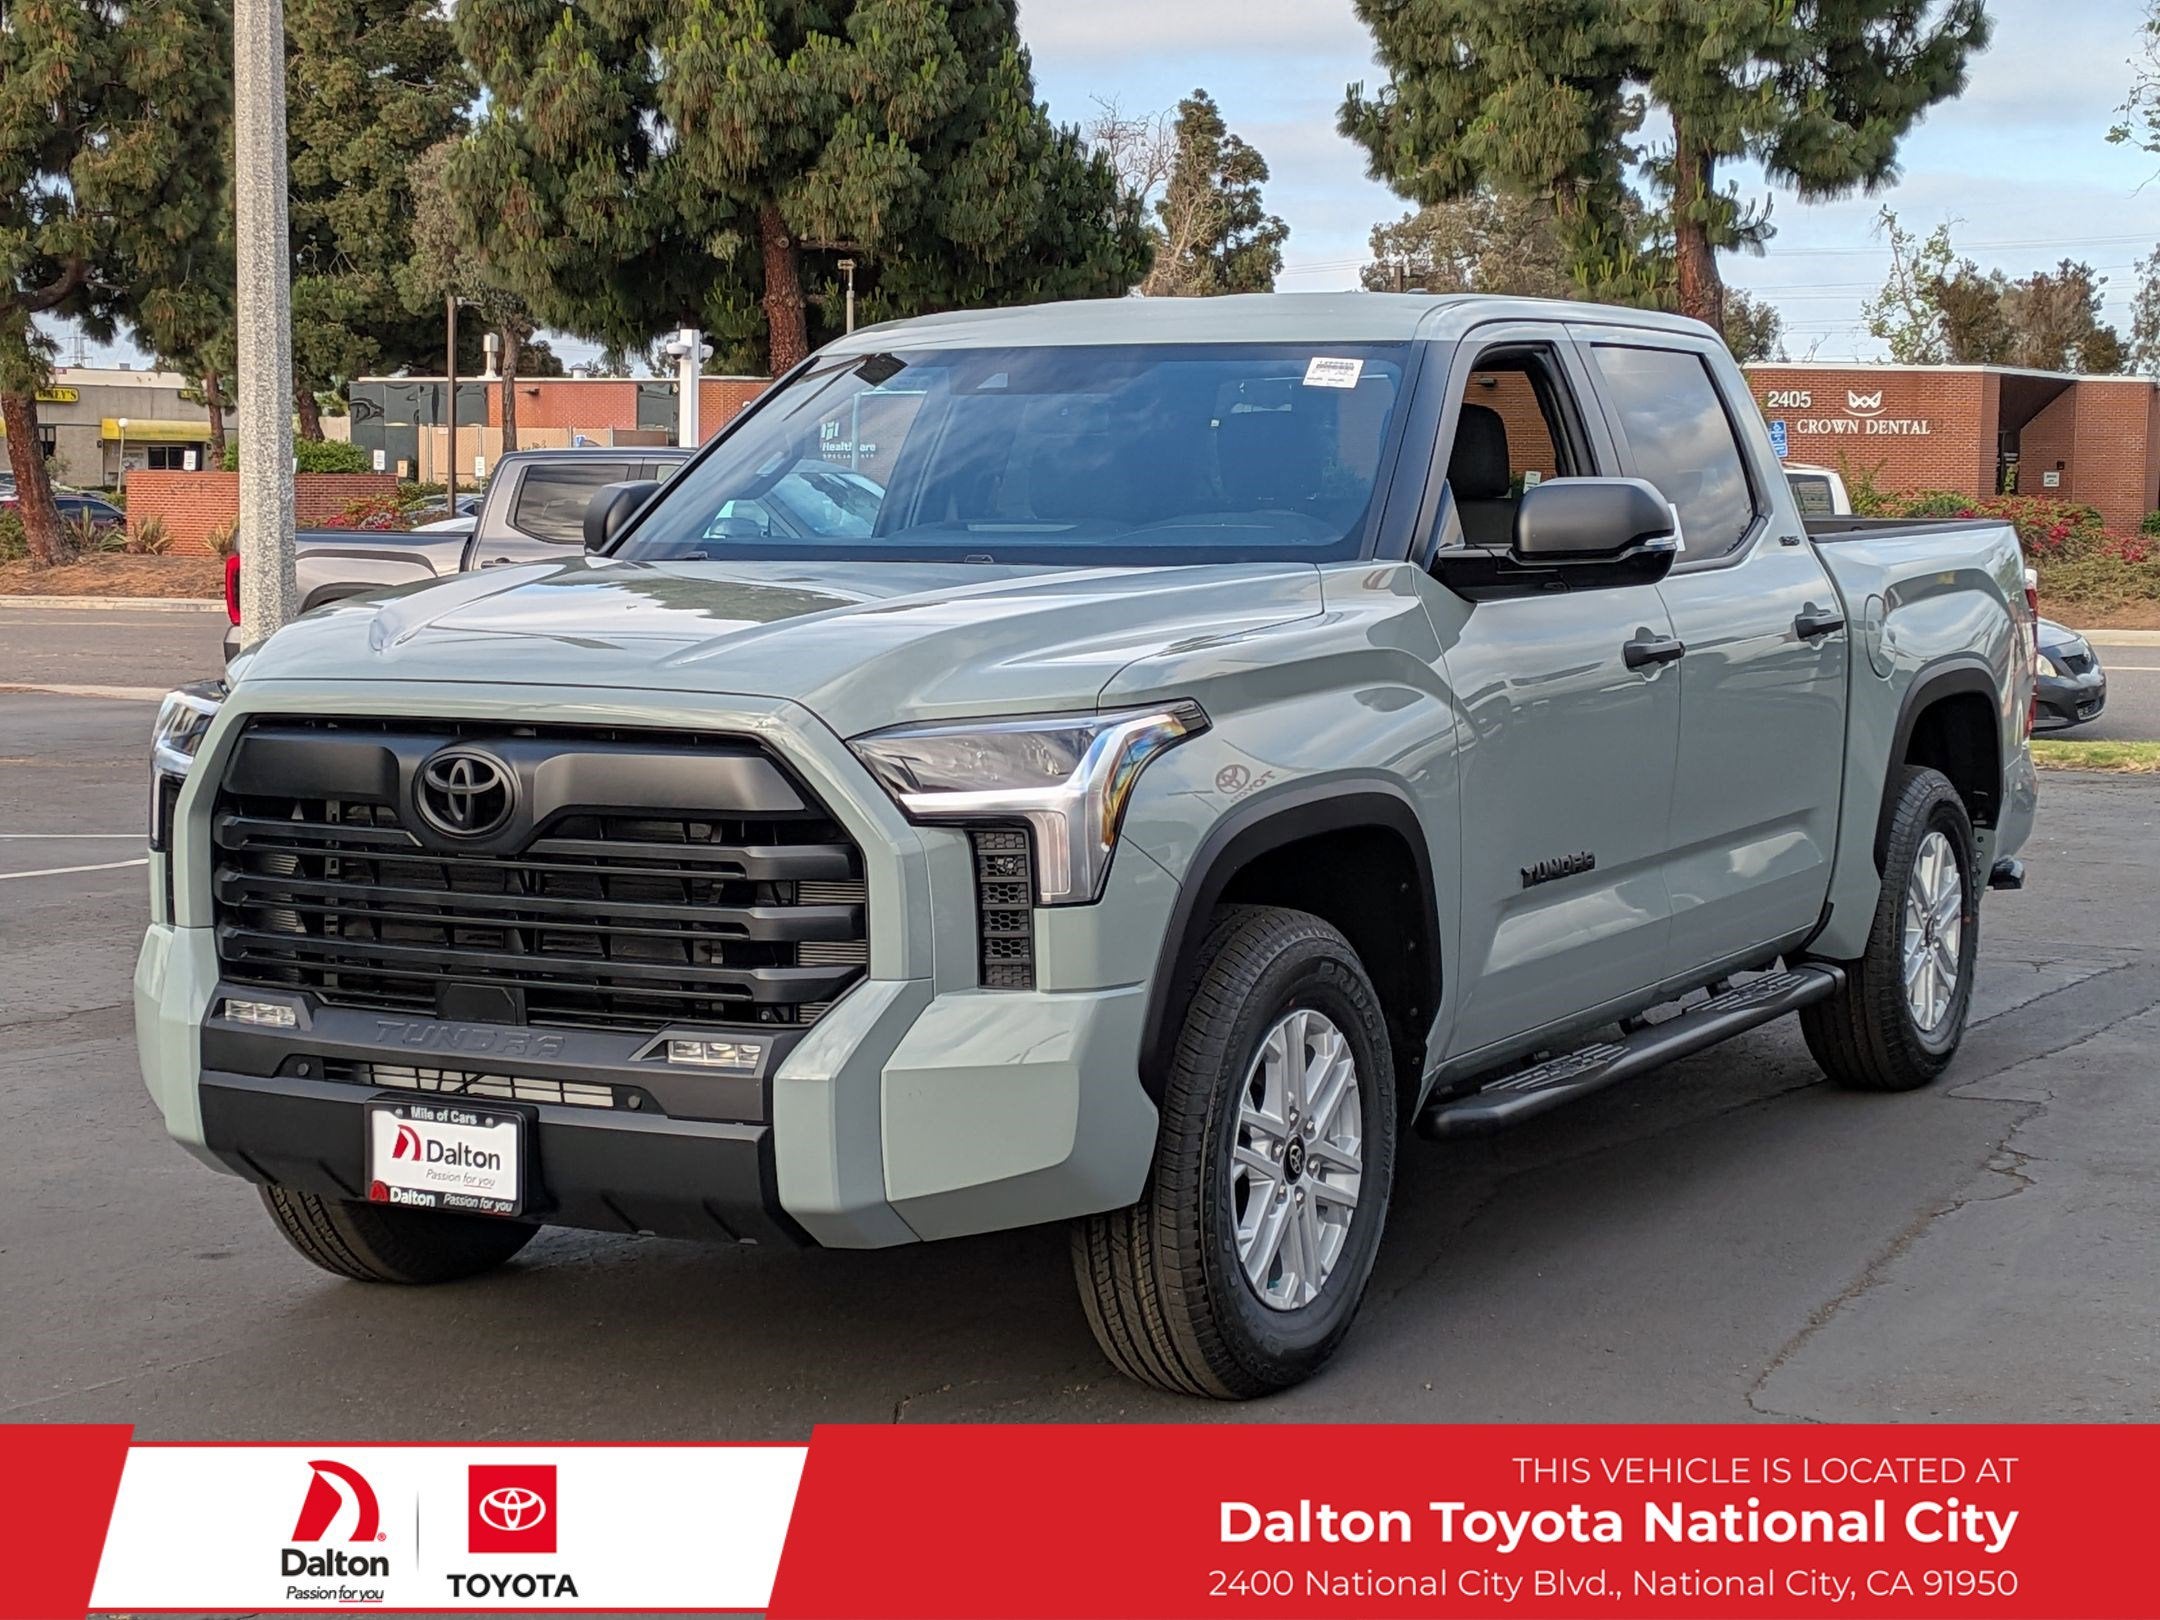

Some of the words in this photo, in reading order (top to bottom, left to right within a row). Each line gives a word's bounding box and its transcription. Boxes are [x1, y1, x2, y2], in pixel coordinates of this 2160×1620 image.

[1767, 390, 1812, 409] 2405
[1797, 419, 1859, 435] CROWN
[1865, 420, 1931, 435] DENTAL
[376, 1020, 566, 1058] TUNDRA
[410, 1105, 434, 1120] Mile
[436, 1109, 449, 1122] of
[450, 1110, 478, 1125] Cars
[426, 1139, 501, 1171] Dalton
[425, 1168, 461, 1183] Passion
[463, 1172, 477, 1185] for
[478, 1177, 496, 1188] you
[389, 1187, 436, 1208] Dalton
[443, 1193, 478, 1209] Passion
[479, 1198, 493, 1210] for
[494, 1202, 513, 1214] you
